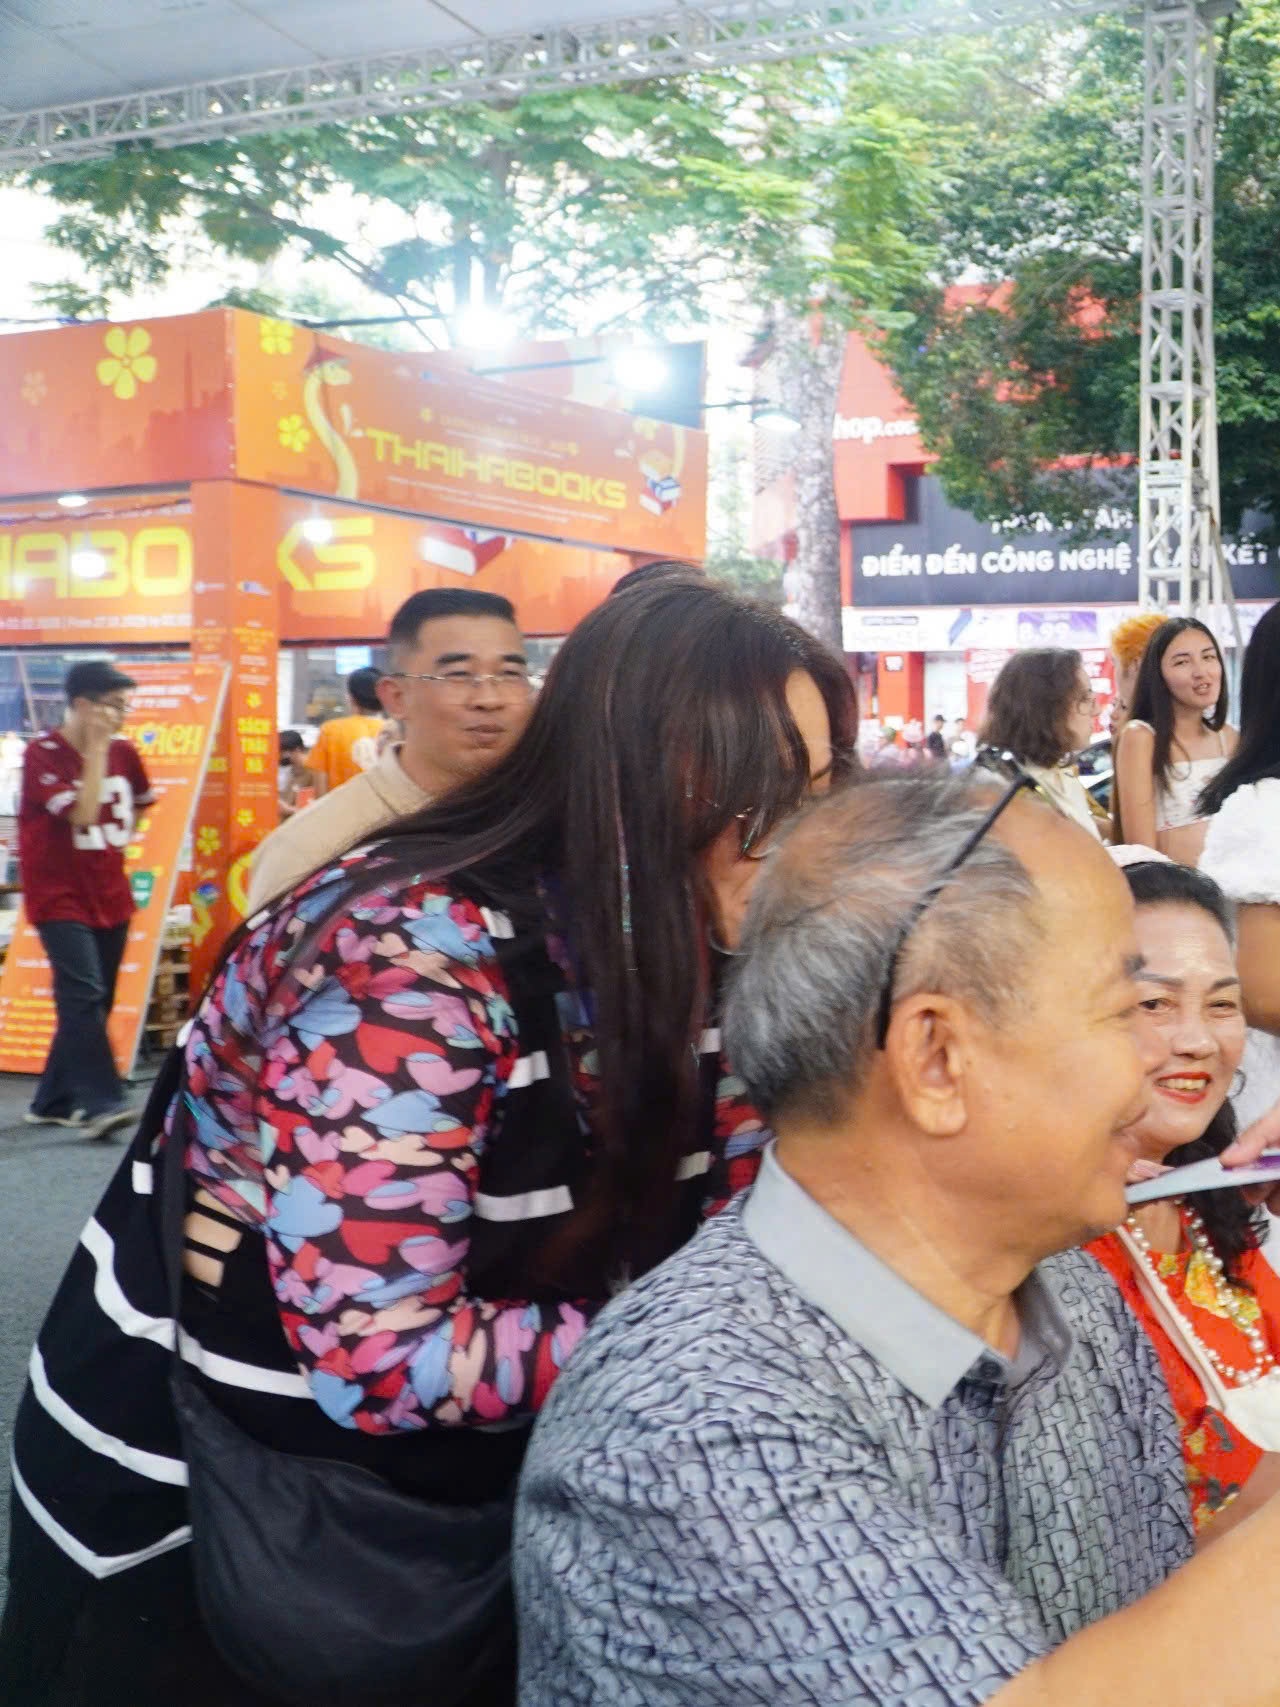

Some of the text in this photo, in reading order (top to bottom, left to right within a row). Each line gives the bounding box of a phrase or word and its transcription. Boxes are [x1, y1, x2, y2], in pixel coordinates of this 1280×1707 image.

[366, 428, 628, 510] THAIHABOOKS
[861, 543, 922, 578] ĐIỂM
[925, 543, 977, 576] ĐẾN
[981, 545, 1054, 575] CÔNG
[1059, 542, 1132, 576] NGHỆ
